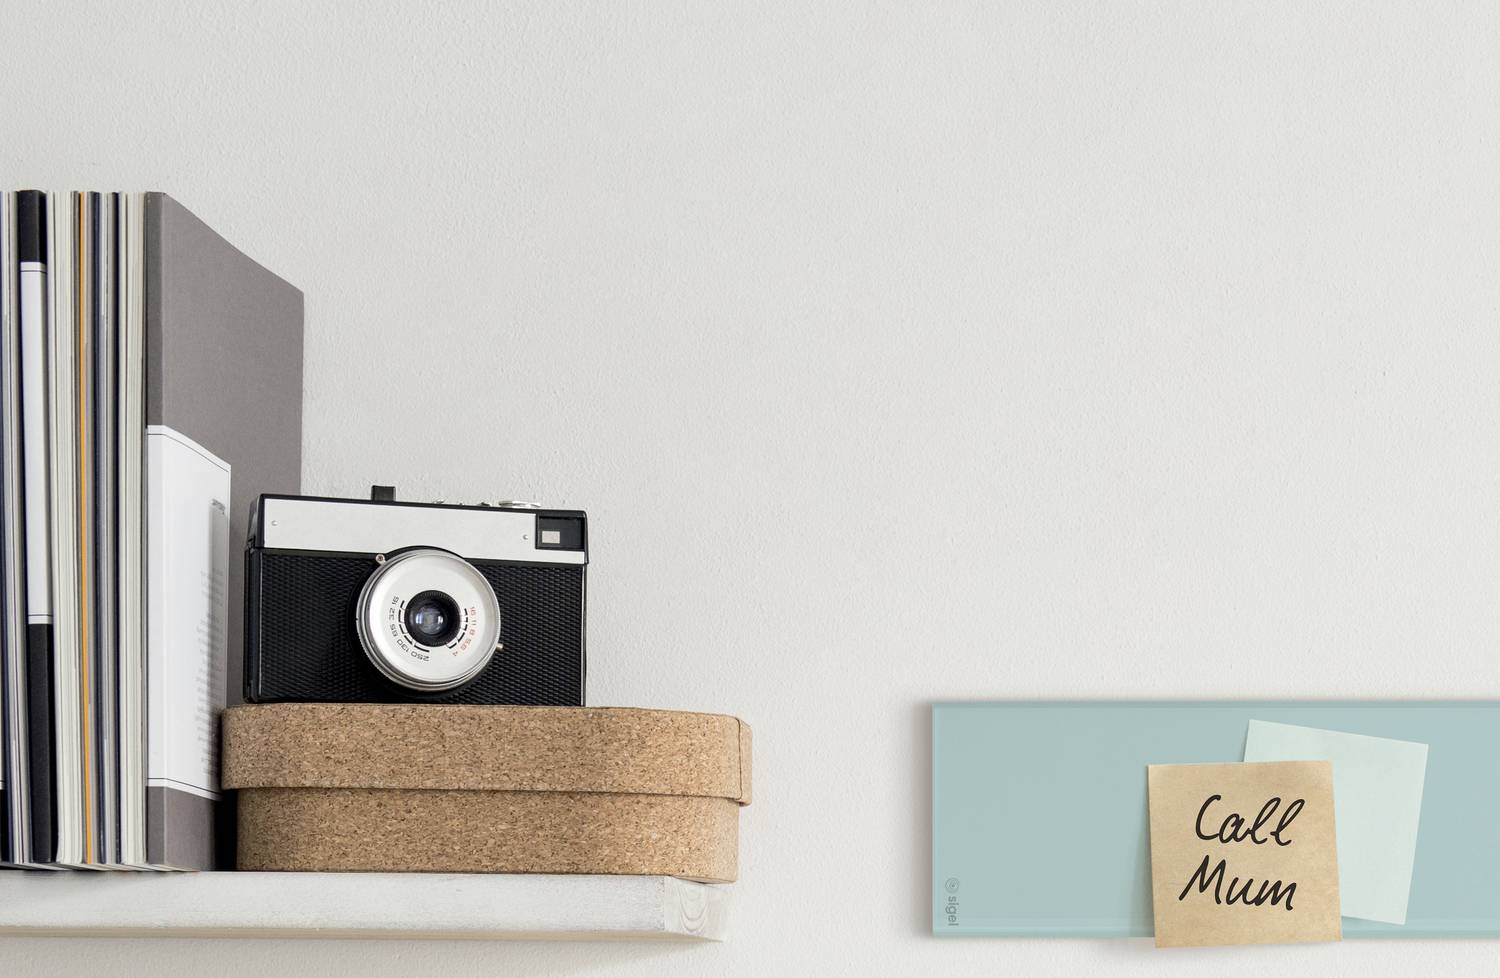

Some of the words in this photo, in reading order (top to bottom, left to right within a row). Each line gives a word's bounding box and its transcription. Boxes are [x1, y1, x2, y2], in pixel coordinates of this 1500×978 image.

[1195, 794, 1305, 846] Call
[1178, 854, 1297, 911] Mum
[945, 896, 960, 927] sigel
